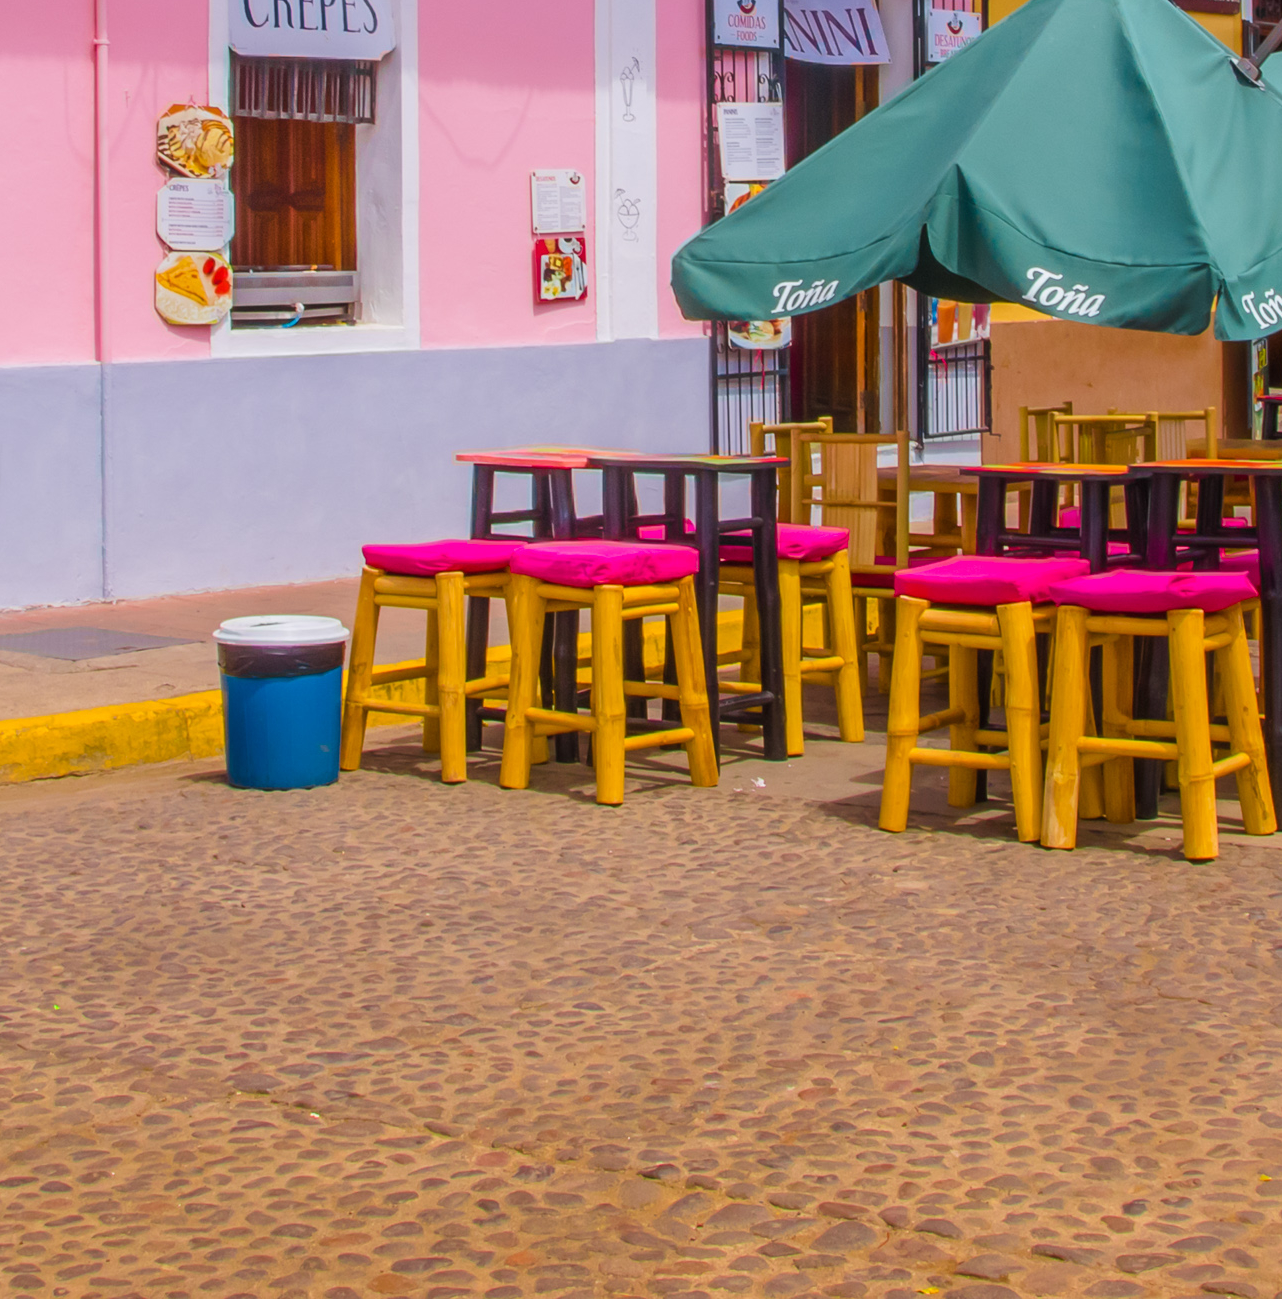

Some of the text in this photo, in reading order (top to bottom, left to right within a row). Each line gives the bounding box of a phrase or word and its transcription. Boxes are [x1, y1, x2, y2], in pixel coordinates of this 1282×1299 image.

[727, 13, 766, 30] COMIDAS
[736, 30, 757, 41] FOODS
[784, 7, 879, 57] NINI
[771, 278, 840, 314] Toña
[1023, 266, 1106, 319] Toña
